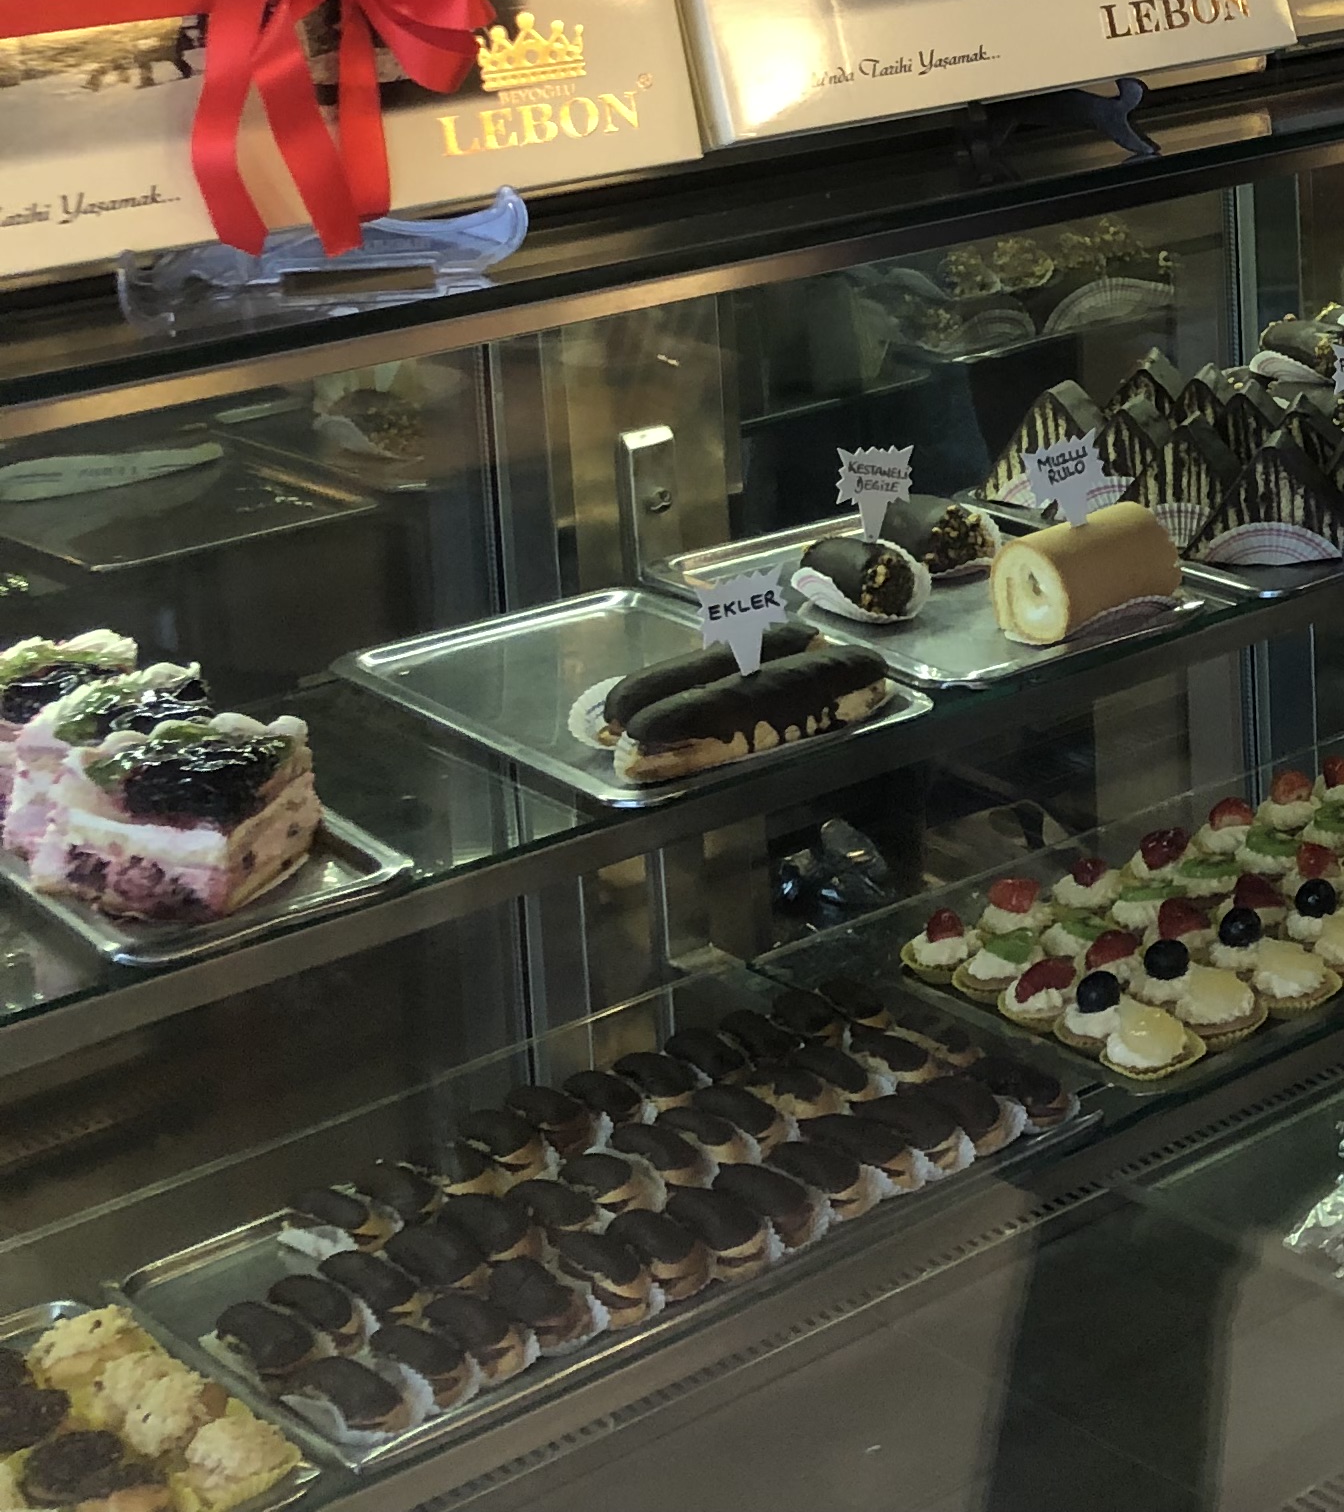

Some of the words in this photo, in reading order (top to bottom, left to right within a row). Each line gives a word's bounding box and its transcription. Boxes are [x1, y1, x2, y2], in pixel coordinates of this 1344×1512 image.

[858, 56, 913, 78] Tarihi
[436, 90, 640, 157] LEBON
[1047, 458, 1087, 486] RULO
[708, 589, 781, 621] EKLER
